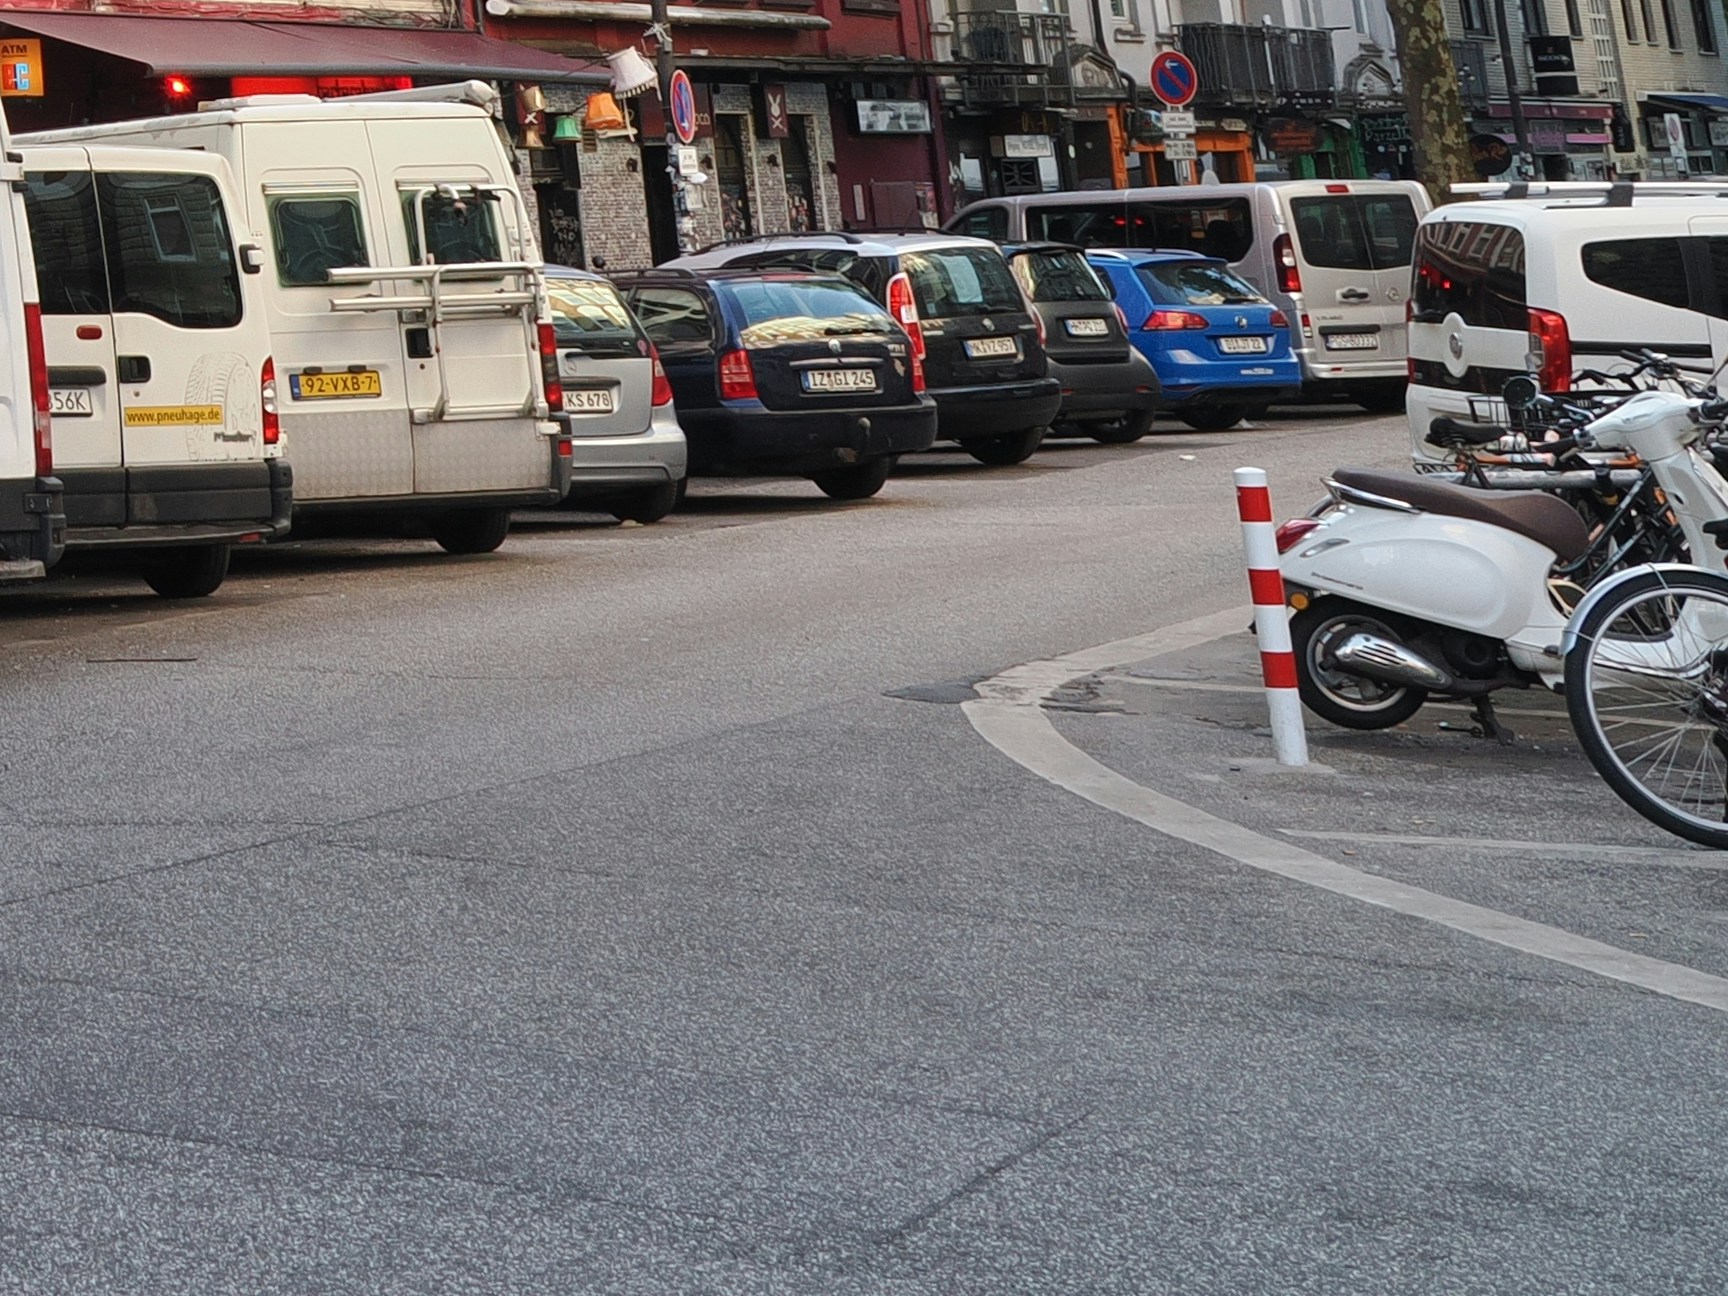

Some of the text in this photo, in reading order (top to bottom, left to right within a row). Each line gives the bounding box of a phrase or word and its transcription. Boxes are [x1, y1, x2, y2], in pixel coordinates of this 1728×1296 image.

[1, 44, 28, 54] ATM
[851, 371, 874, 385] 245
[566, 392, 610, 408] KS 678
[127, 409, 221, 424] www.pneuhage.de
